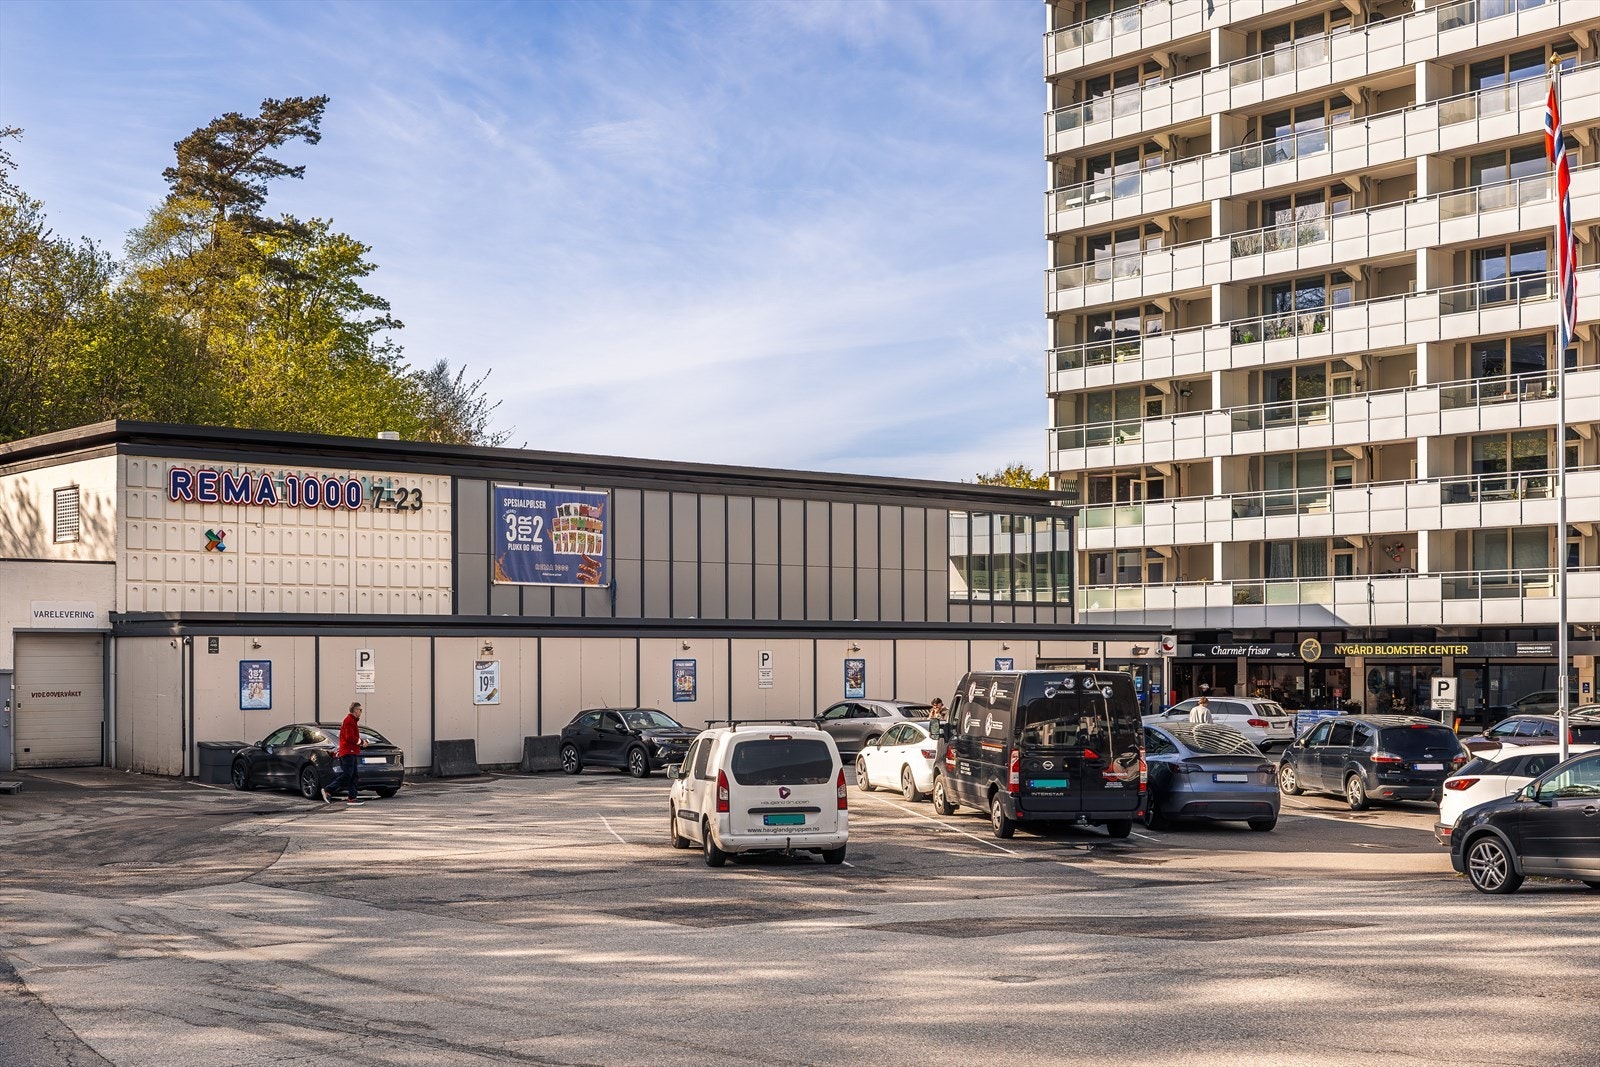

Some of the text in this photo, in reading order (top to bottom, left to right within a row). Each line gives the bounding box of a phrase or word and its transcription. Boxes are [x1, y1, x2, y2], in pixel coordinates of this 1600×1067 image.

[168, 467, 423, 511] REMA 1000 7-23
[504, 498, 546, 509] SPESIALPØLSER
[506, 514, 543, 543] 3 FOR 2
[508, 543, 522, 551] PLUKK
[34, 610, 94, 619] VARELEVERING
[1211, 645, 1246, 655] Charmèr
[1246, 645, 1271, 657] frisør
[1334, 643, 1469, 655] NYGÅRD BLOMSTER CENTER
[360, 652, 370, 667] P
[762, 653, 769, 666] P
[479, 676, 489, 691] 19
[1438, 681, 1450, 696] P
[31, 690, 81, 698] VIDEOOVERVÅKET
